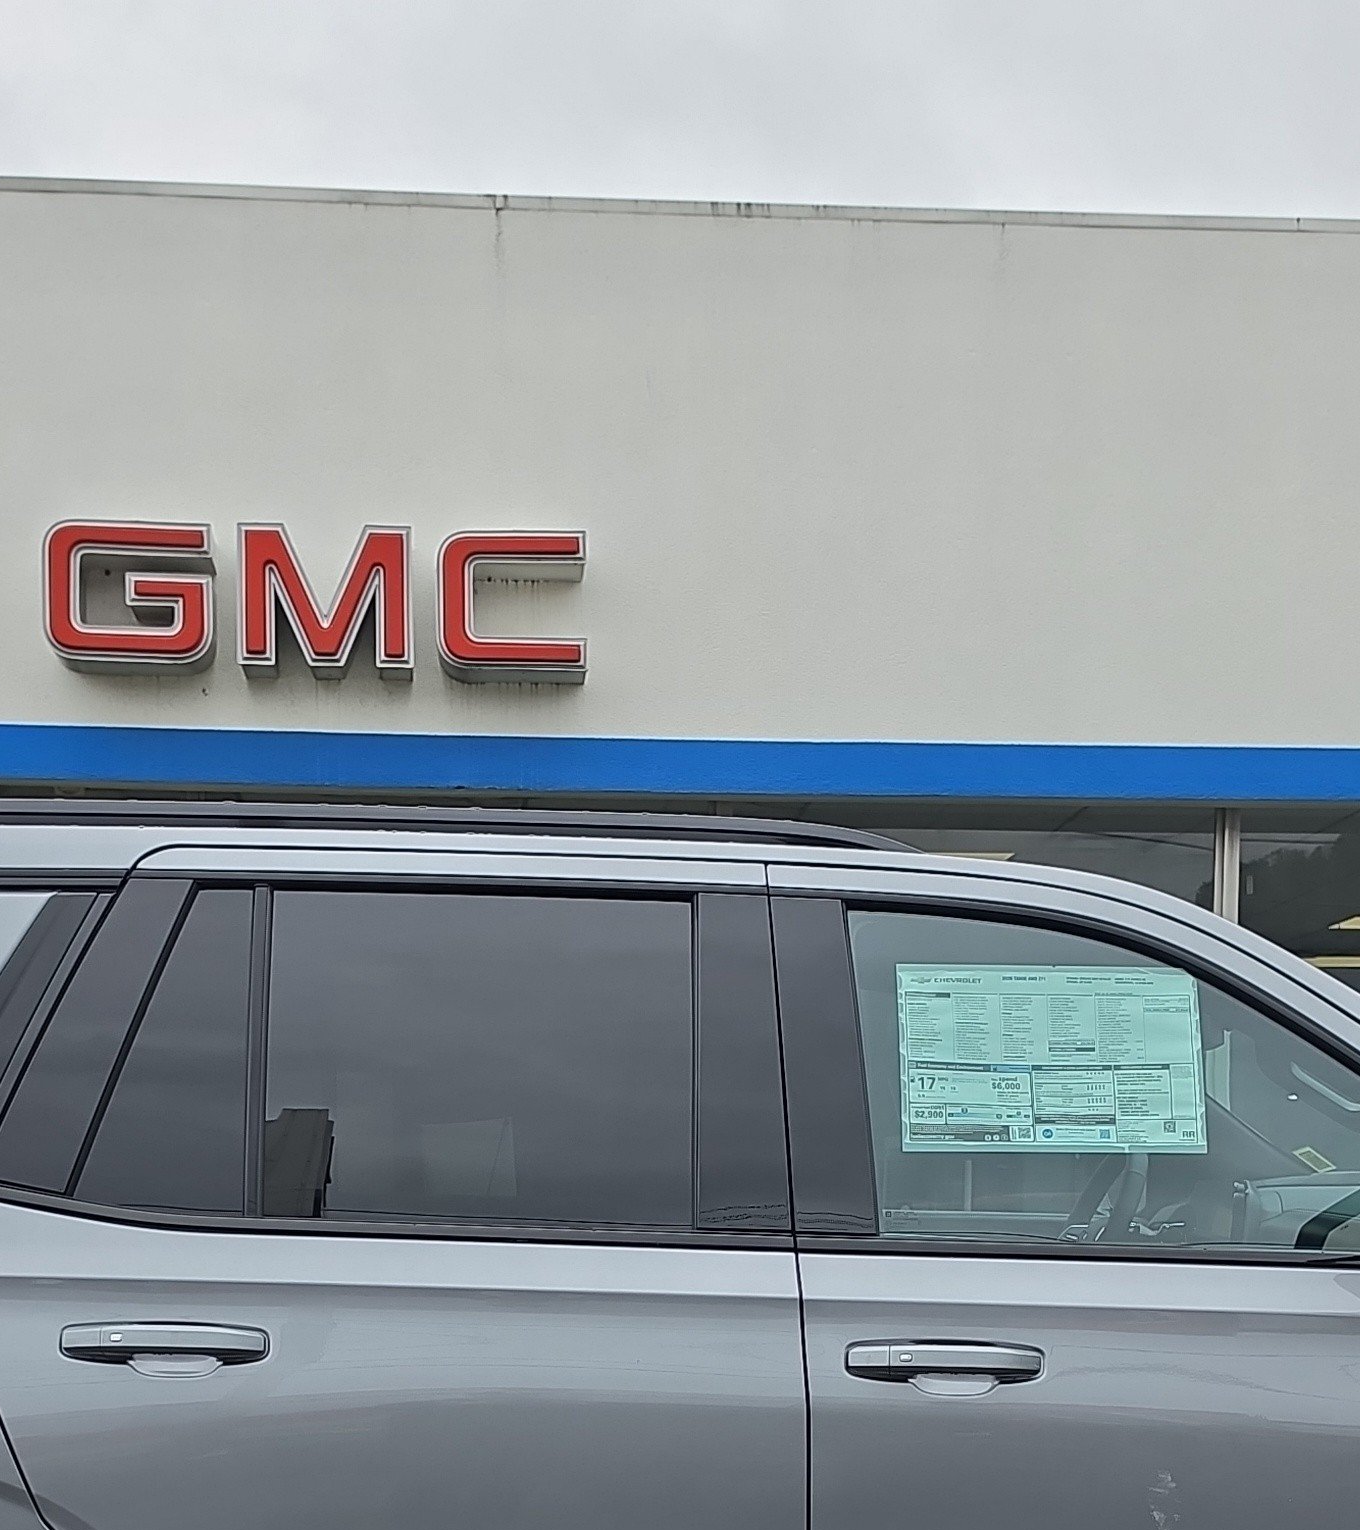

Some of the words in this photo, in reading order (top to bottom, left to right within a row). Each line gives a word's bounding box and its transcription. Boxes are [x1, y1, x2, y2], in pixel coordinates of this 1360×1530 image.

[43, 520, 587, 672] GMC
[917, 1076, 936, 1090] 17
[991, 1081, 1021, 1090] $6,000
[915, 1110, 944, 1119] $2,900
[1182, 1130, 1195, 1138] RR
